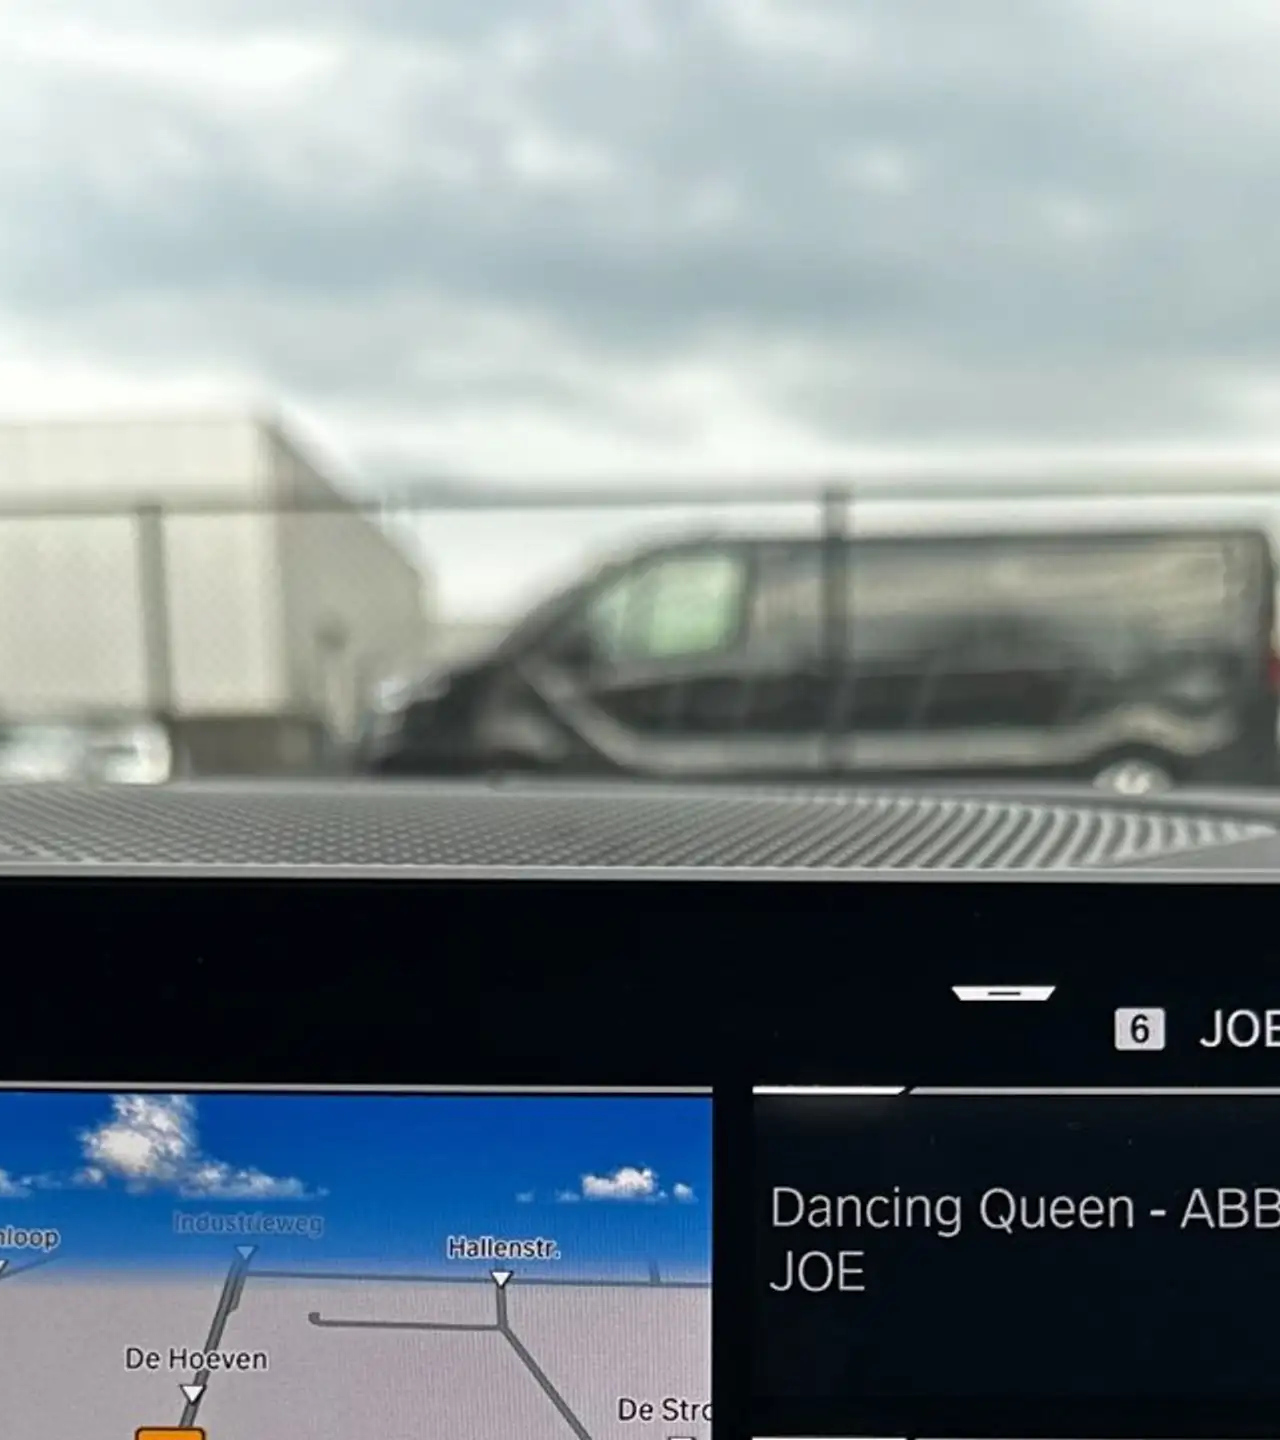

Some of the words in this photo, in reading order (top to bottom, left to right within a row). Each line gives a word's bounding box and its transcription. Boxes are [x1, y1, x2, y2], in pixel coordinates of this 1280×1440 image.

[1127, 1013, 1152, 1047] 6
[173, 1211, 324, 1237] Industrieweg
[769, 1187, 965, 1238] Dancing
[978, 1190, 1135, 1235] Queen
[447, 1236, 561, 1261] Hallenstr.
[769, 1251, 866, 1293] JOE
[125, 1348, 162, 1371] De
[169, 1348, 268, 1371] Hoeven
[618, 1398, 654, 1423] De
